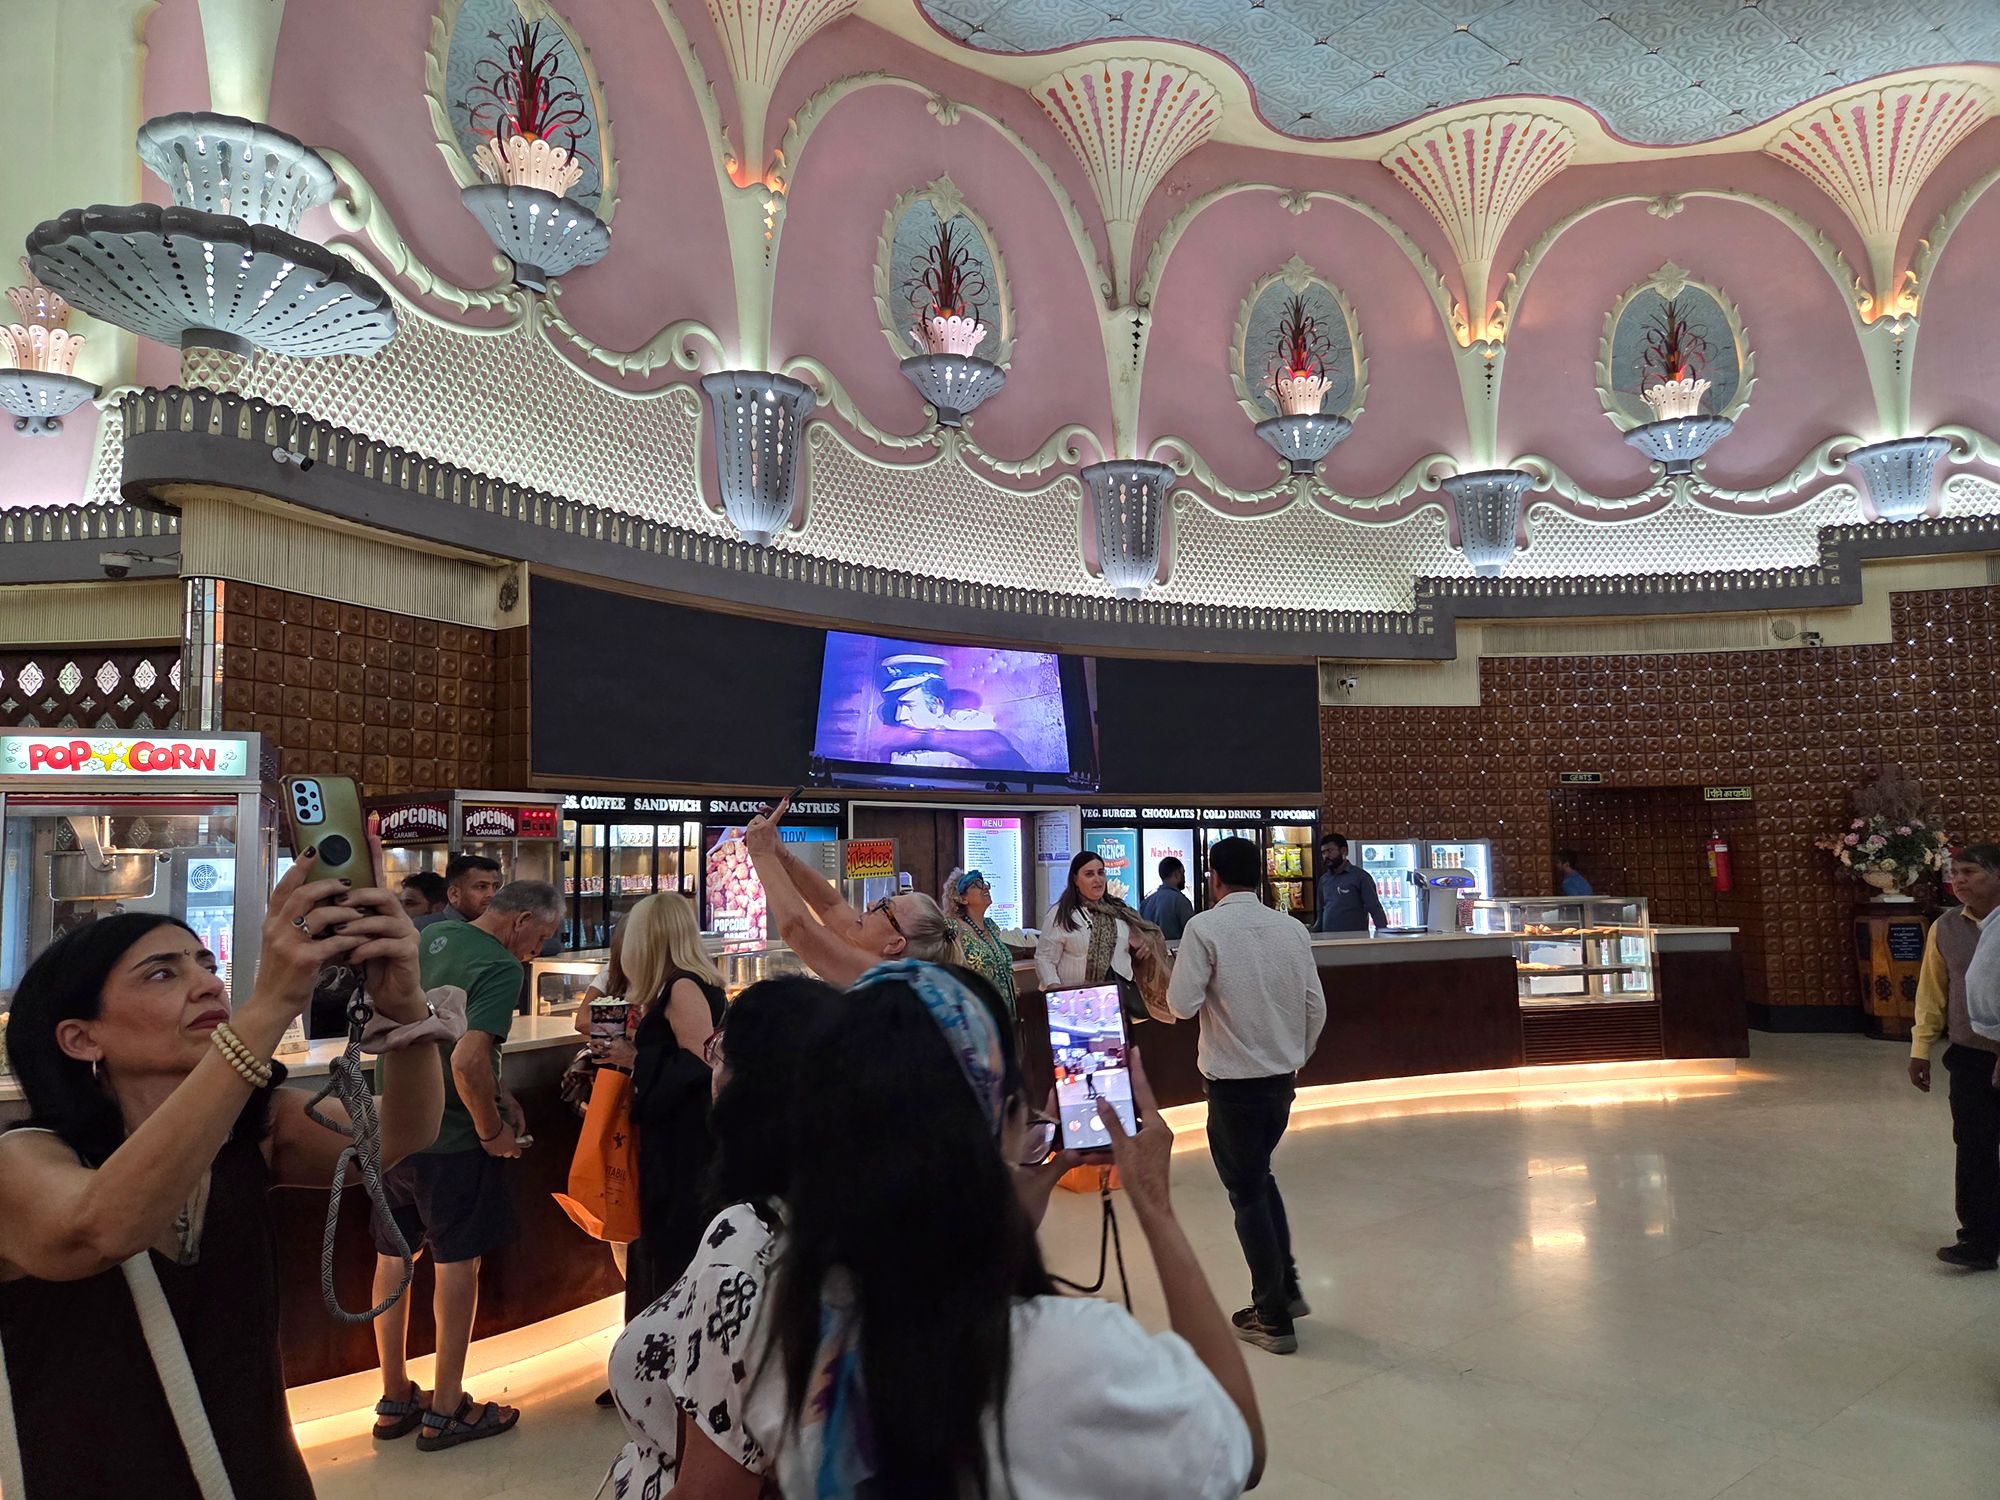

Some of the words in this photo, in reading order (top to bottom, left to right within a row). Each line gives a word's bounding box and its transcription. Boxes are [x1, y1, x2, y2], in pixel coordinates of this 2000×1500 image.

[29, 740, 92, 771] POP
[129, 741, 216, 772] CORN
[581, 796, 626, 810] COFFEE
[634, 798, 702, 812] SANDWICH
[783, 802, 840, 814] ASTRIES
[1081, 808, 1101, 818] VEG.
[1102, 808, 1137, 818] BURGER
[1141, 808, 1195, 819] CHOCOLATES
[1203, 809, 1227, 819] COLD
[1227, 809, 1262, 819] DRINKS
[1270, 809, 1316, 820] POPCORN
[381, 807, 447, 835] POPCORN
[466, 807, 515, 832] POPCORN
[981, 819, 1003, 828] MENU
[851, 847, 890, 874] Nachos
[1097, 844, 1126, 860] FRENCH
[1150, 847, 1184, 858] Nachos
